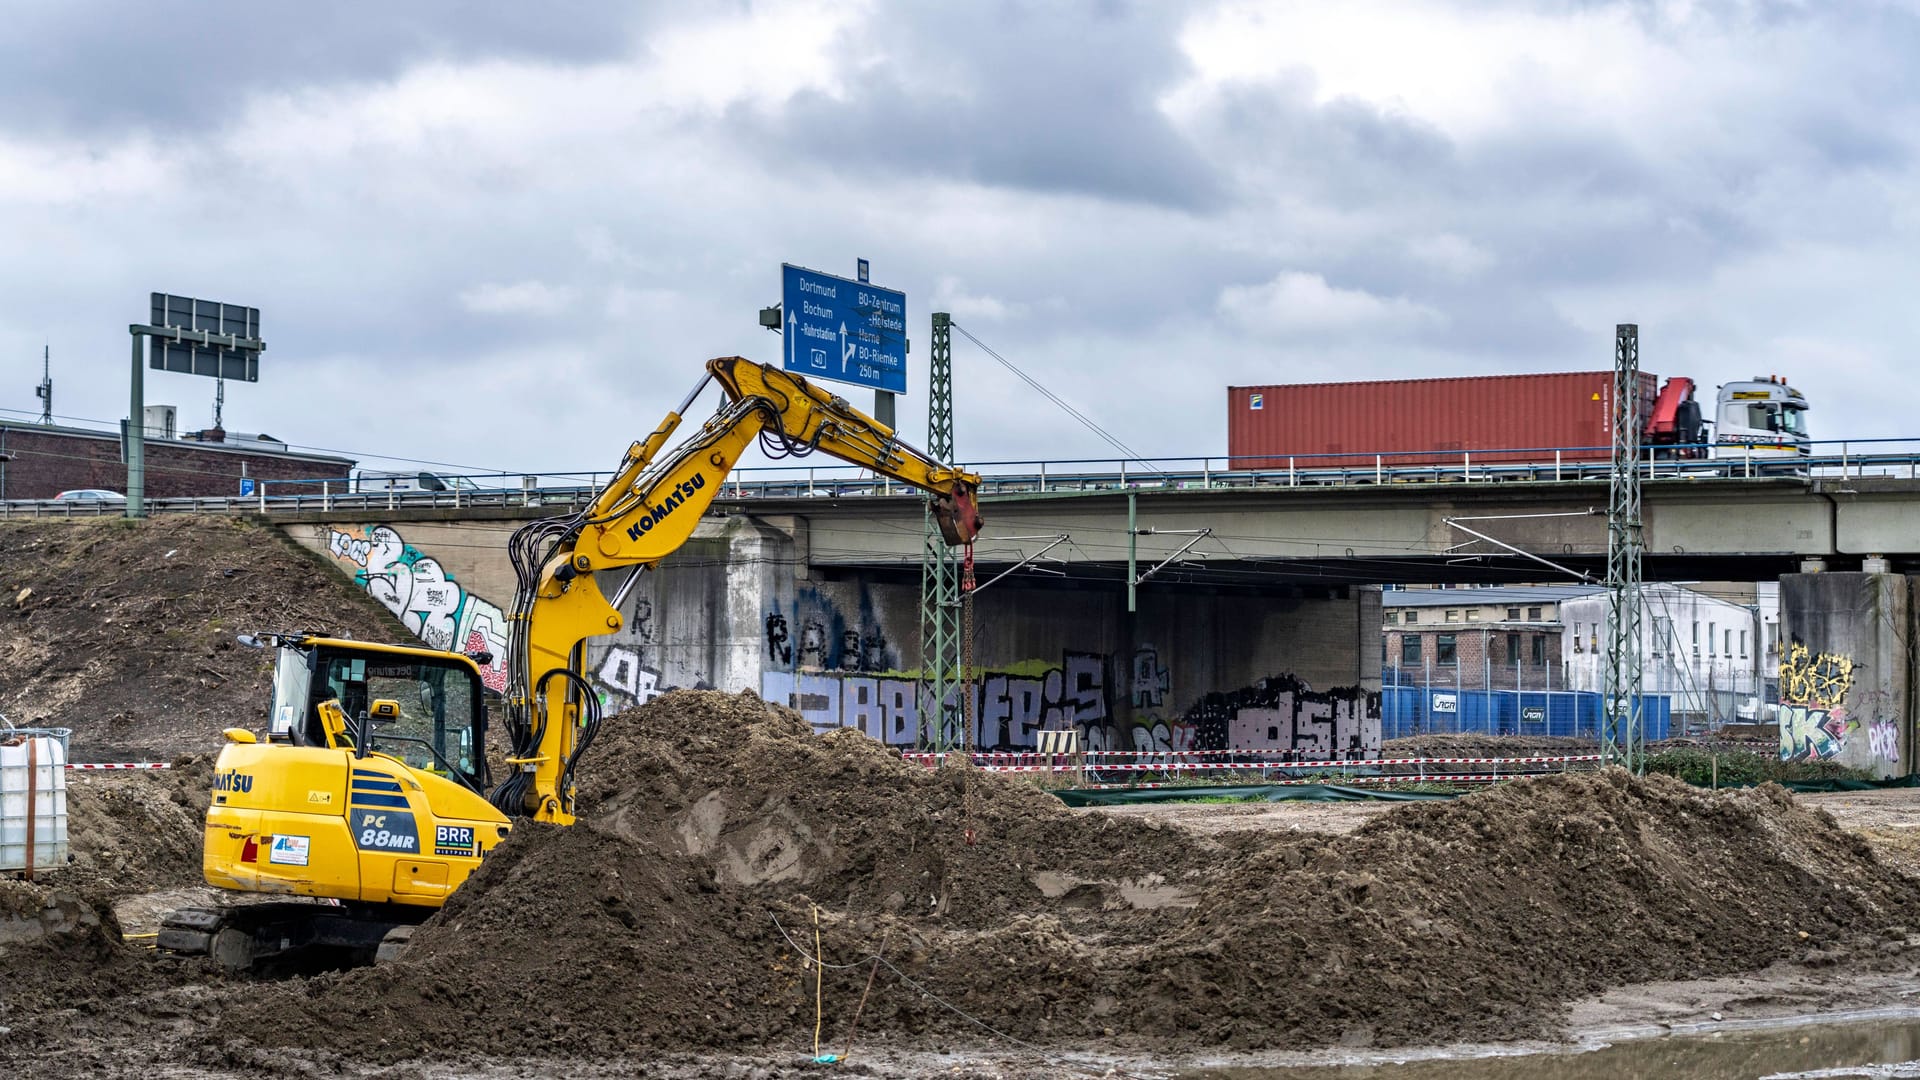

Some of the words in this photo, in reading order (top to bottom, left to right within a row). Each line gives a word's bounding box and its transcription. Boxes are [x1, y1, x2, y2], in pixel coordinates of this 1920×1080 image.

[800, 277, 836, 298] Dortmund
[803, 300, 833, 319] Bochum
[800, 322, 837, 342] -Ruhrstadion
[858, 328, 880, 345] Herne
[814, 353, 823, 365] 40
[859, 346, 898, 366] BO-Riemke
[859, 364, 872, 378] 250
[872, 370, 880, 380] m
[627, 472, 706, 542] KOMATSU
[362, 814, 387, 828] PC
[360, 829, 415, 849] 88MR
[437, 826, 470, 843] BRR
